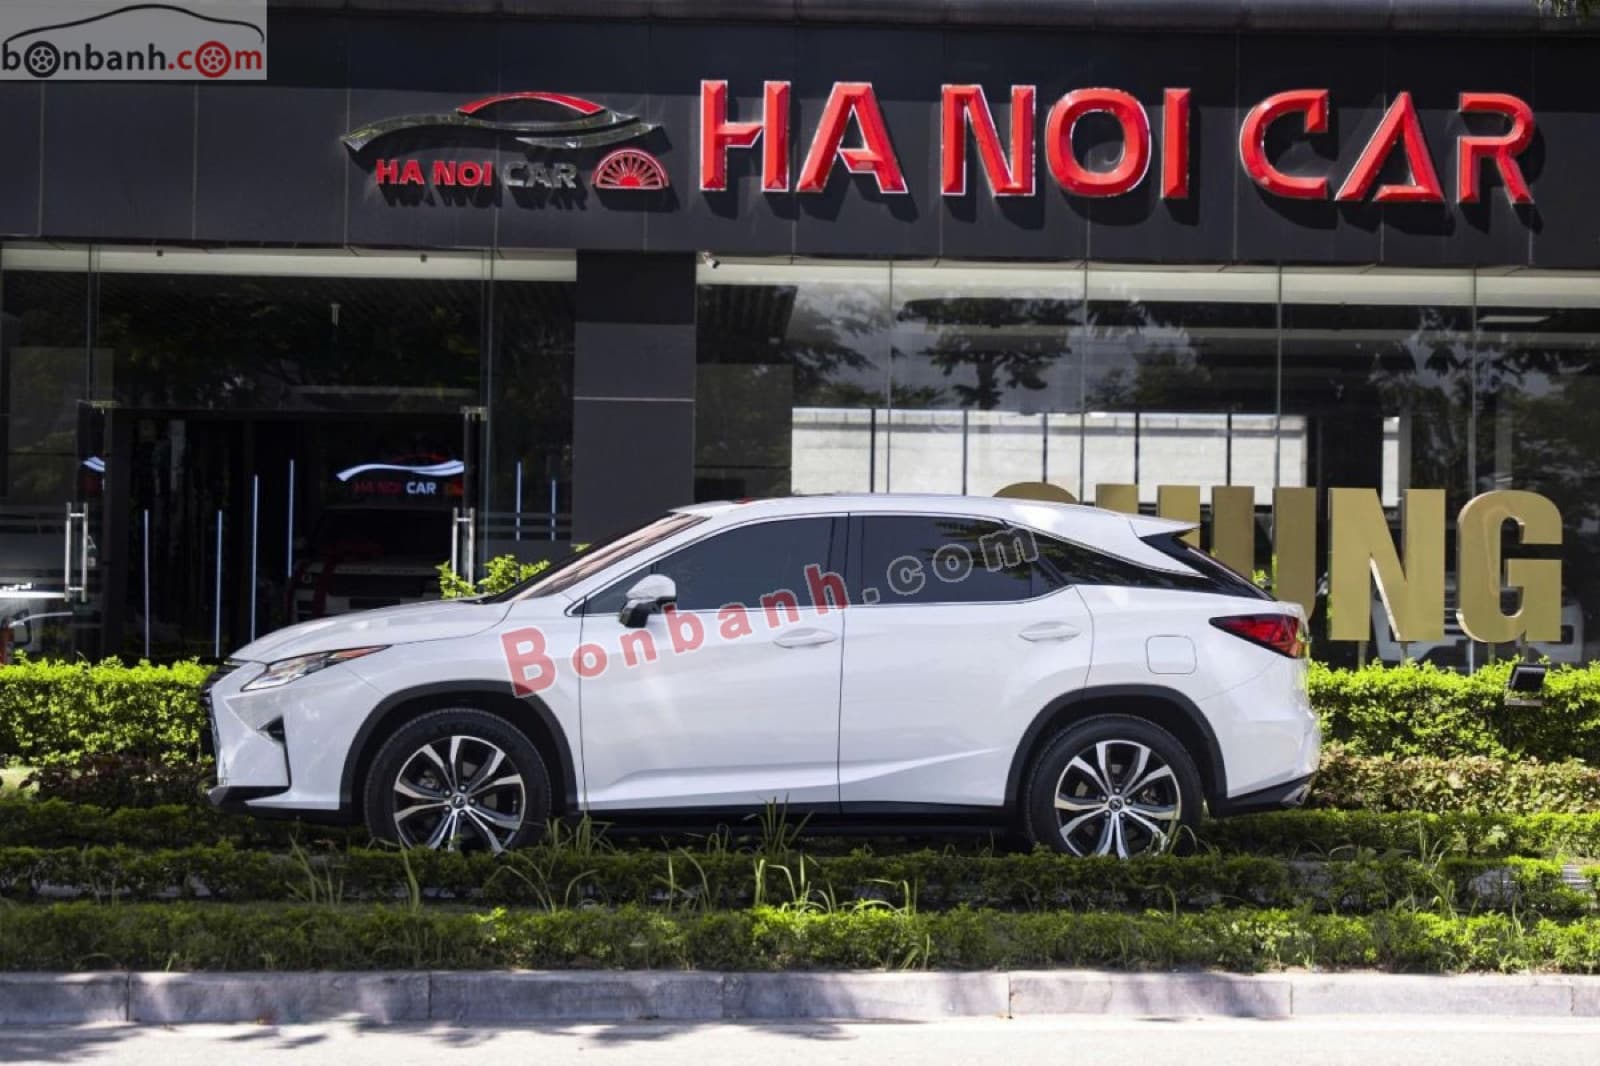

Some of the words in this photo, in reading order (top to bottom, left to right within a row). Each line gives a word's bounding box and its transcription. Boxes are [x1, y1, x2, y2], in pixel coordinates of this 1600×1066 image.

[375, 158, 425, 185] HA
[432, 160, 494, 188] NOI
[504, 161, 577, 189] CAR
[699, 79, 909, 194] HA
[940, 83, 1191, 199] NOI
[1238, 88, 1535, 205] CAR
[406, 481, 437, 494] CAR
[992, 481, 1563, 643] UNG
